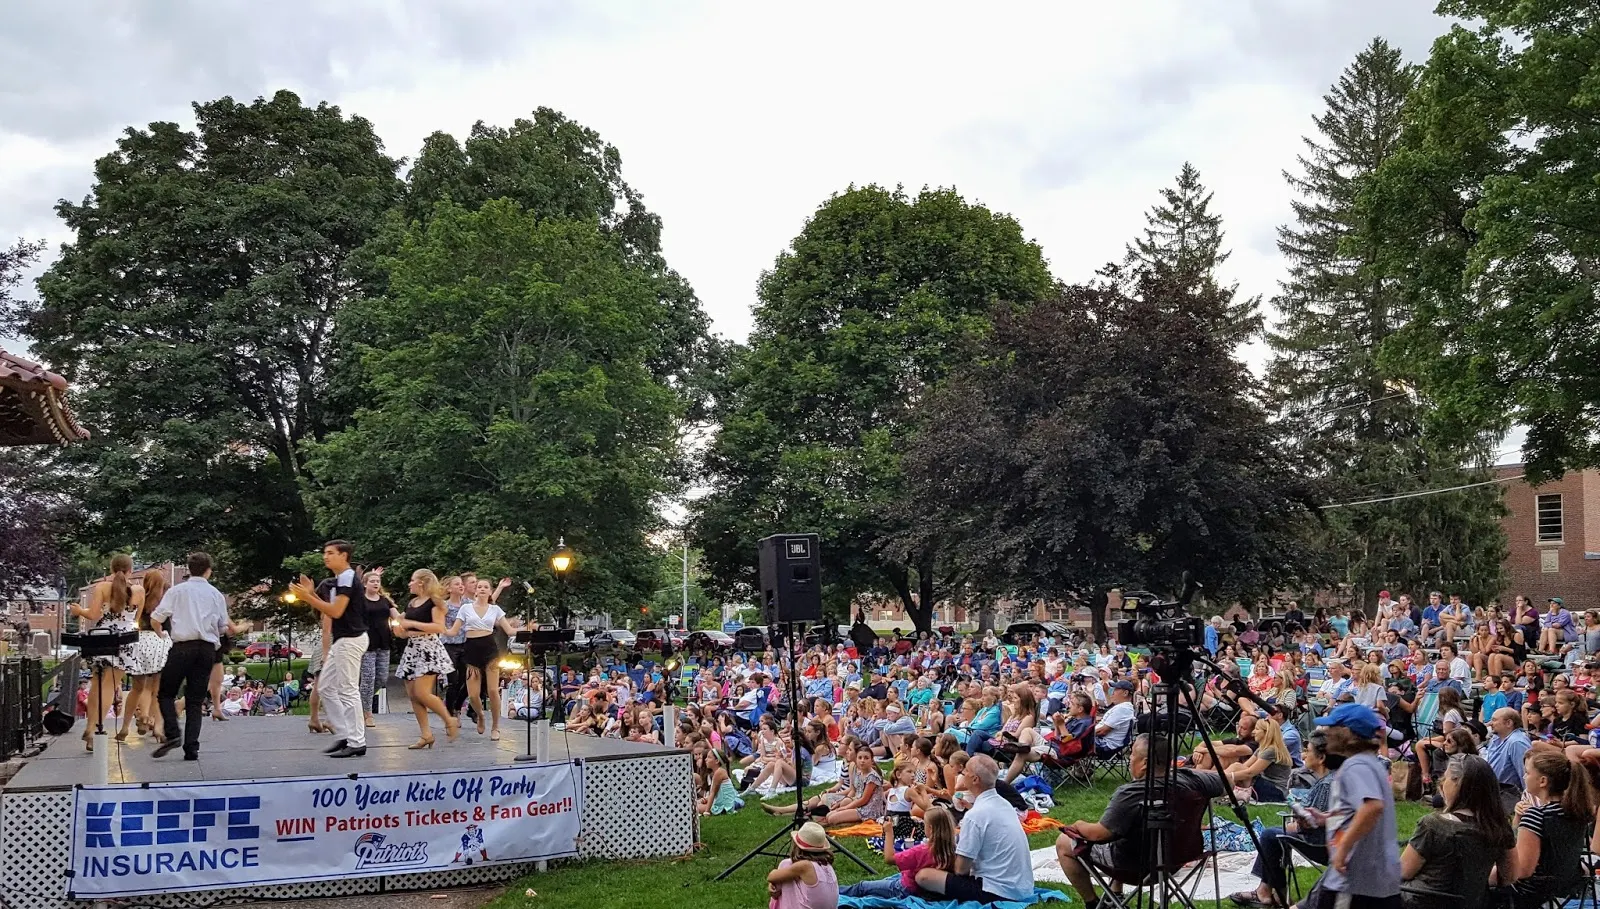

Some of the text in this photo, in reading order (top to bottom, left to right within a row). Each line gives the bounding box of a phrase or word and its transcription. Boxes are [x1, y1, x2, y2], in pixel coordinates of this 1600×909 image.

[790, 544, 806, 554] JBL
[312, 774, 536, 811] 100 Year Kick Off Party
[85, 796, 261, 848] KEEFE
[275, 797, 572, 836] WIN Patriots Tickets & Fan Gear!!
[82, 846, 260, 877] INSURANCE
[355, 840, 429, 870] Patriots
